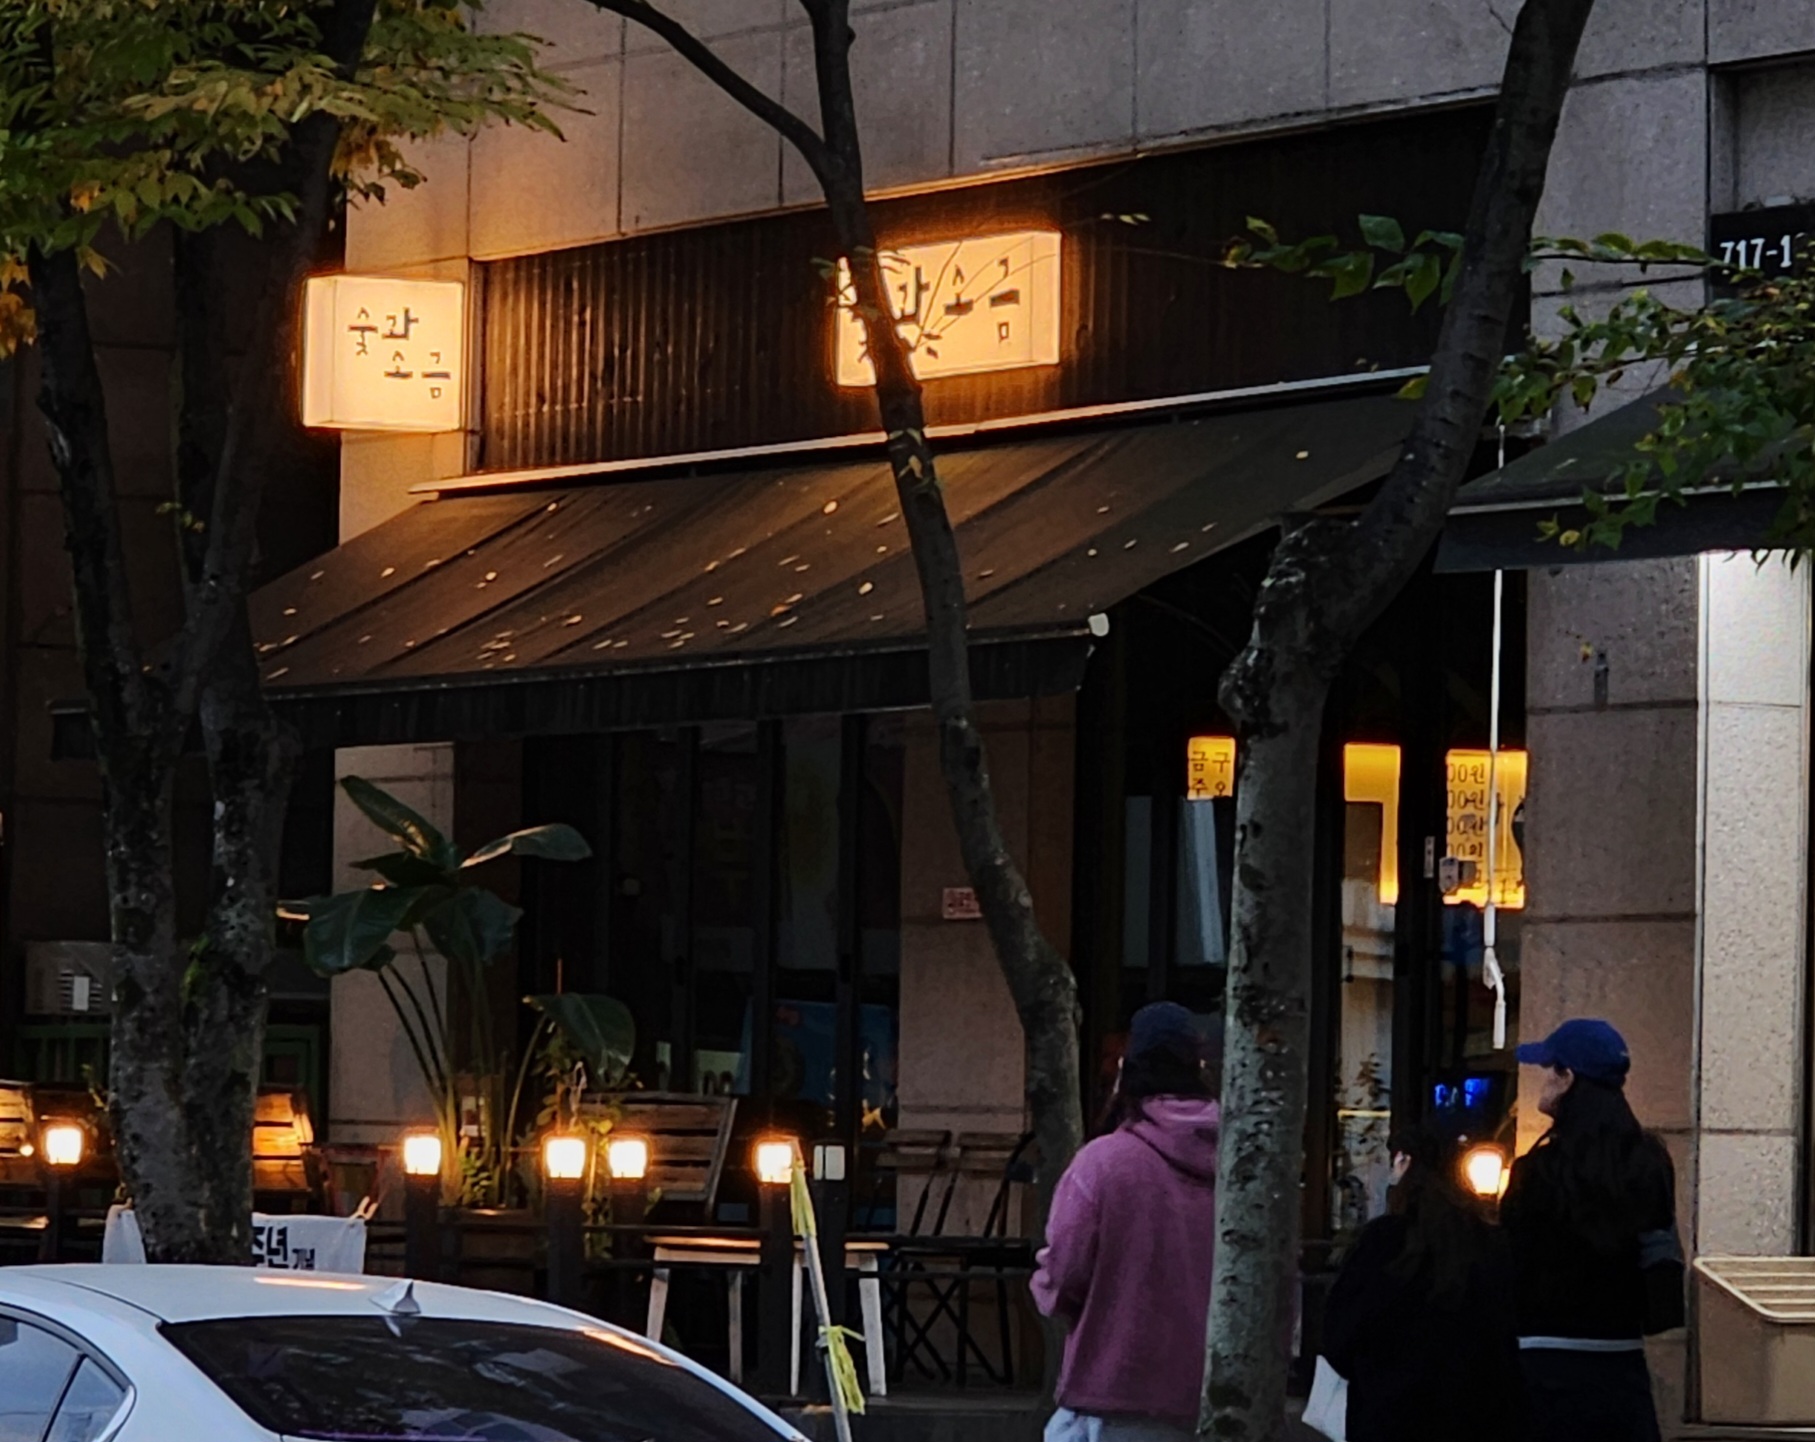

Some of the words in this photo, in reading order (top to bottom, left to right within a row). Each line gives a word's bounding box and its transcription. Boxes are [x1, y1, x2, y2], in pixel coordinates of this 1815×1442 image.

[944, 256, 1020, 342] 소금
[347, 307, 419, 356] 숯과
[384, 350, 451, 399] 소금
